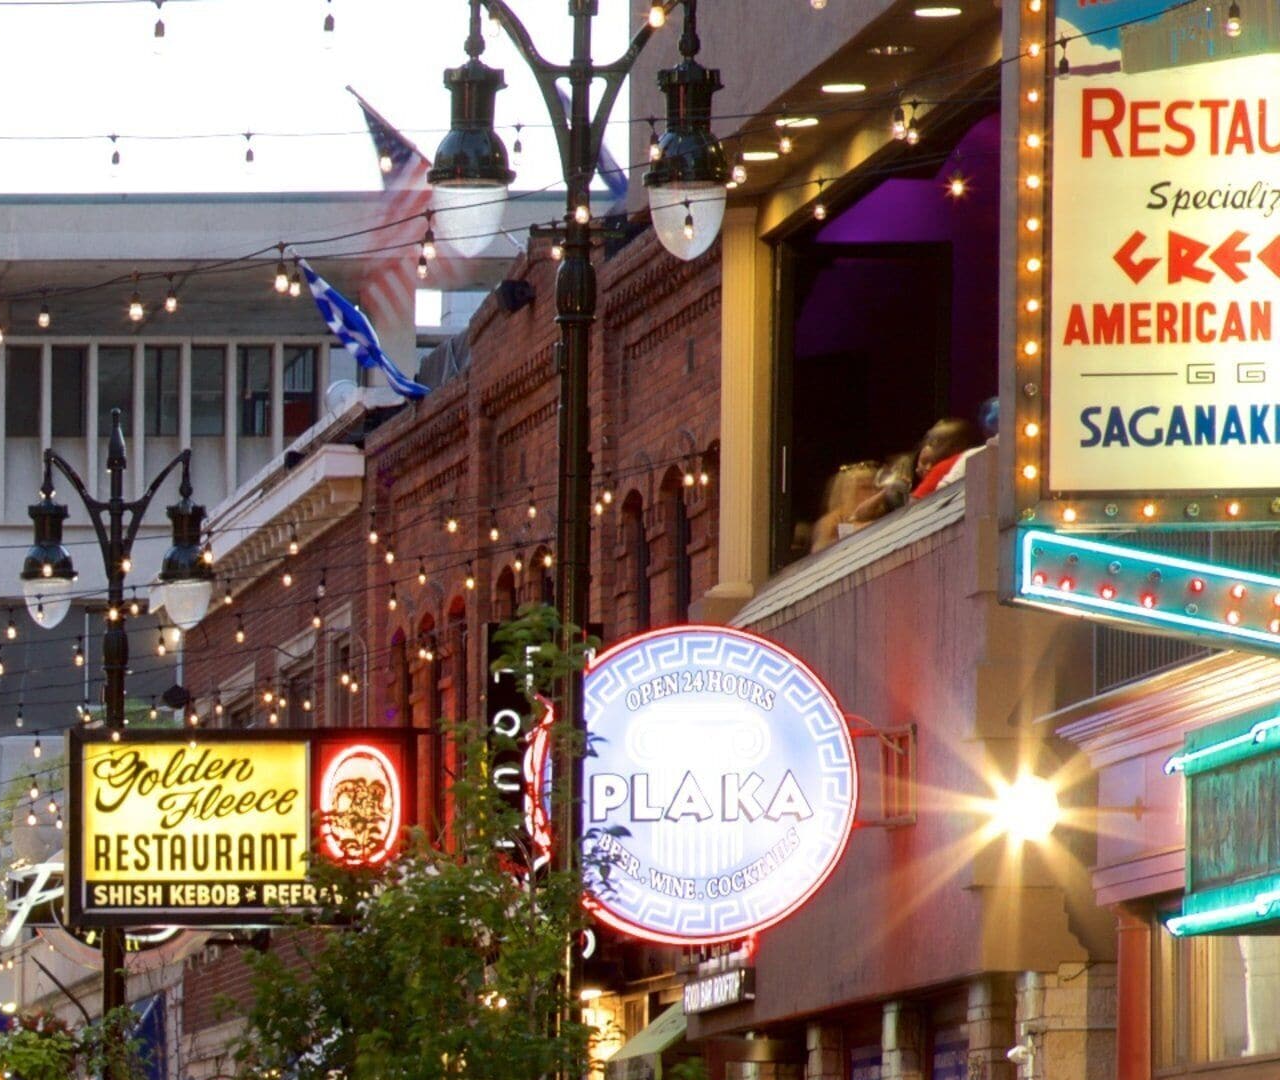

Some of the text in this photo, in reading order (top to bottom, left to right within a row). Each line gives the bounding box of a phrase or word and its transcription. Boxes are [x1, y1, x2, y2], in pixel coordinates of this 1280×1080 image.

[1062, 301, 1272, 347] AMERICAN
[625, 670, 776, 712] OPEN 24 HOURS
[93, 748, 254, 813] Golden
[589, 769, 815, 824] PLAKA
[158, 787, 299, 830] Fleece
[94, 832, 298, 872] RESTAURANT
[649, 867, 697, 900] WINE
[707, 826, 802, 900] COCKTAILS
[94, 885, 162, 906] SHISH
[170, 884, 241, 906] KEBOB
